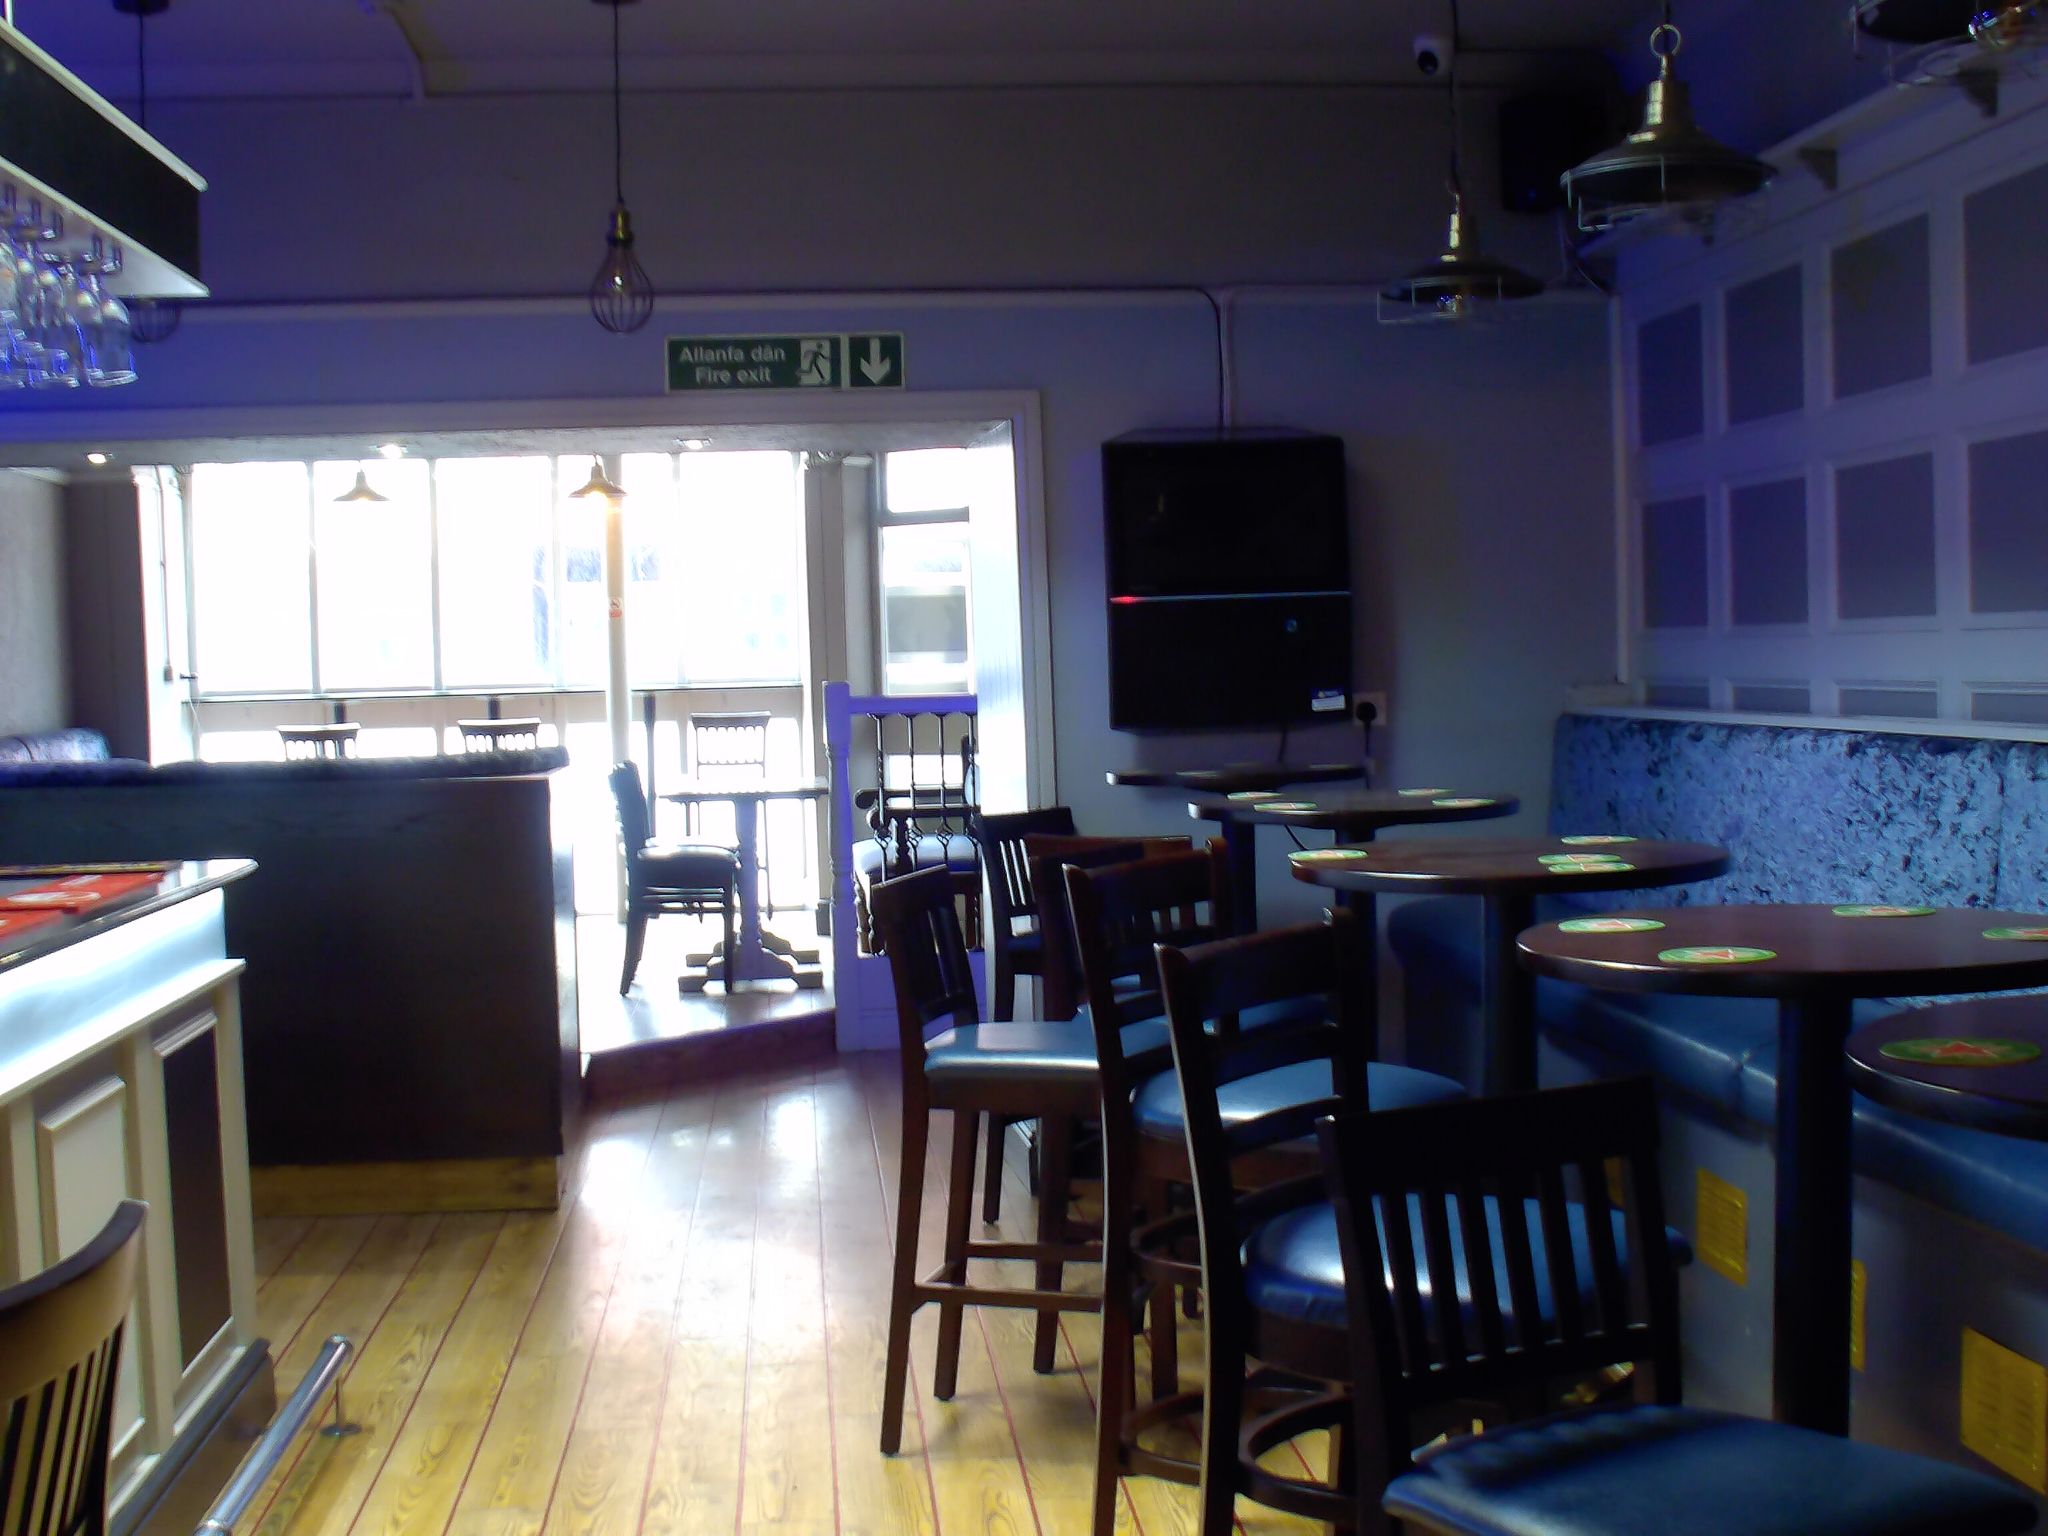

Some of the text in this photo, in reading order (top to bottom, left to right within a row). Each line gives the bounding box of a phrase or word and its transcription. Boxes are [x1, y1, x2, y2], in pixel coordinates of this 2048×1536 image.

[680, 346, 744, 362] Allanfa
[695, 366, 771, 384] Fire exit
